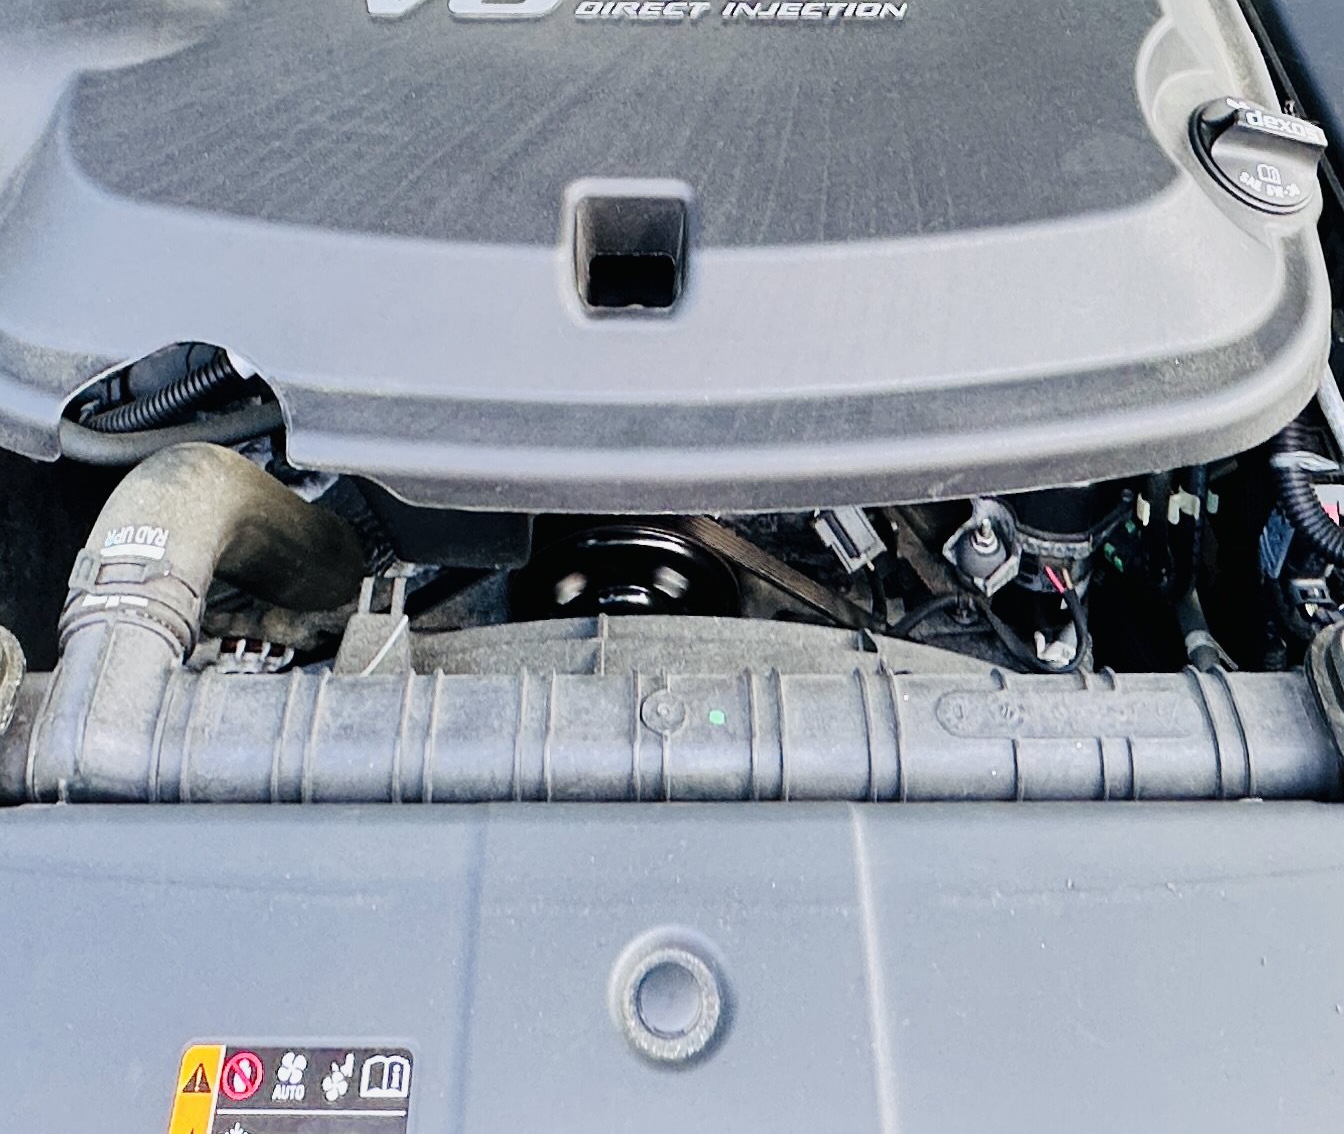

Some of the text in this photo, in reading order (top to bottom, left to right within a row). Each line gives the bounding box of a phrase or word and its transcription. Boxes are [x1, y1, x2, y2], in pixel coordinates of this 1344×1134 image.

[575, 0, 909, 21] DIRECT INJECTION
[104, 524, 170, 547] RAD UPR
[271, 1083, 305, 1101] AUTO
